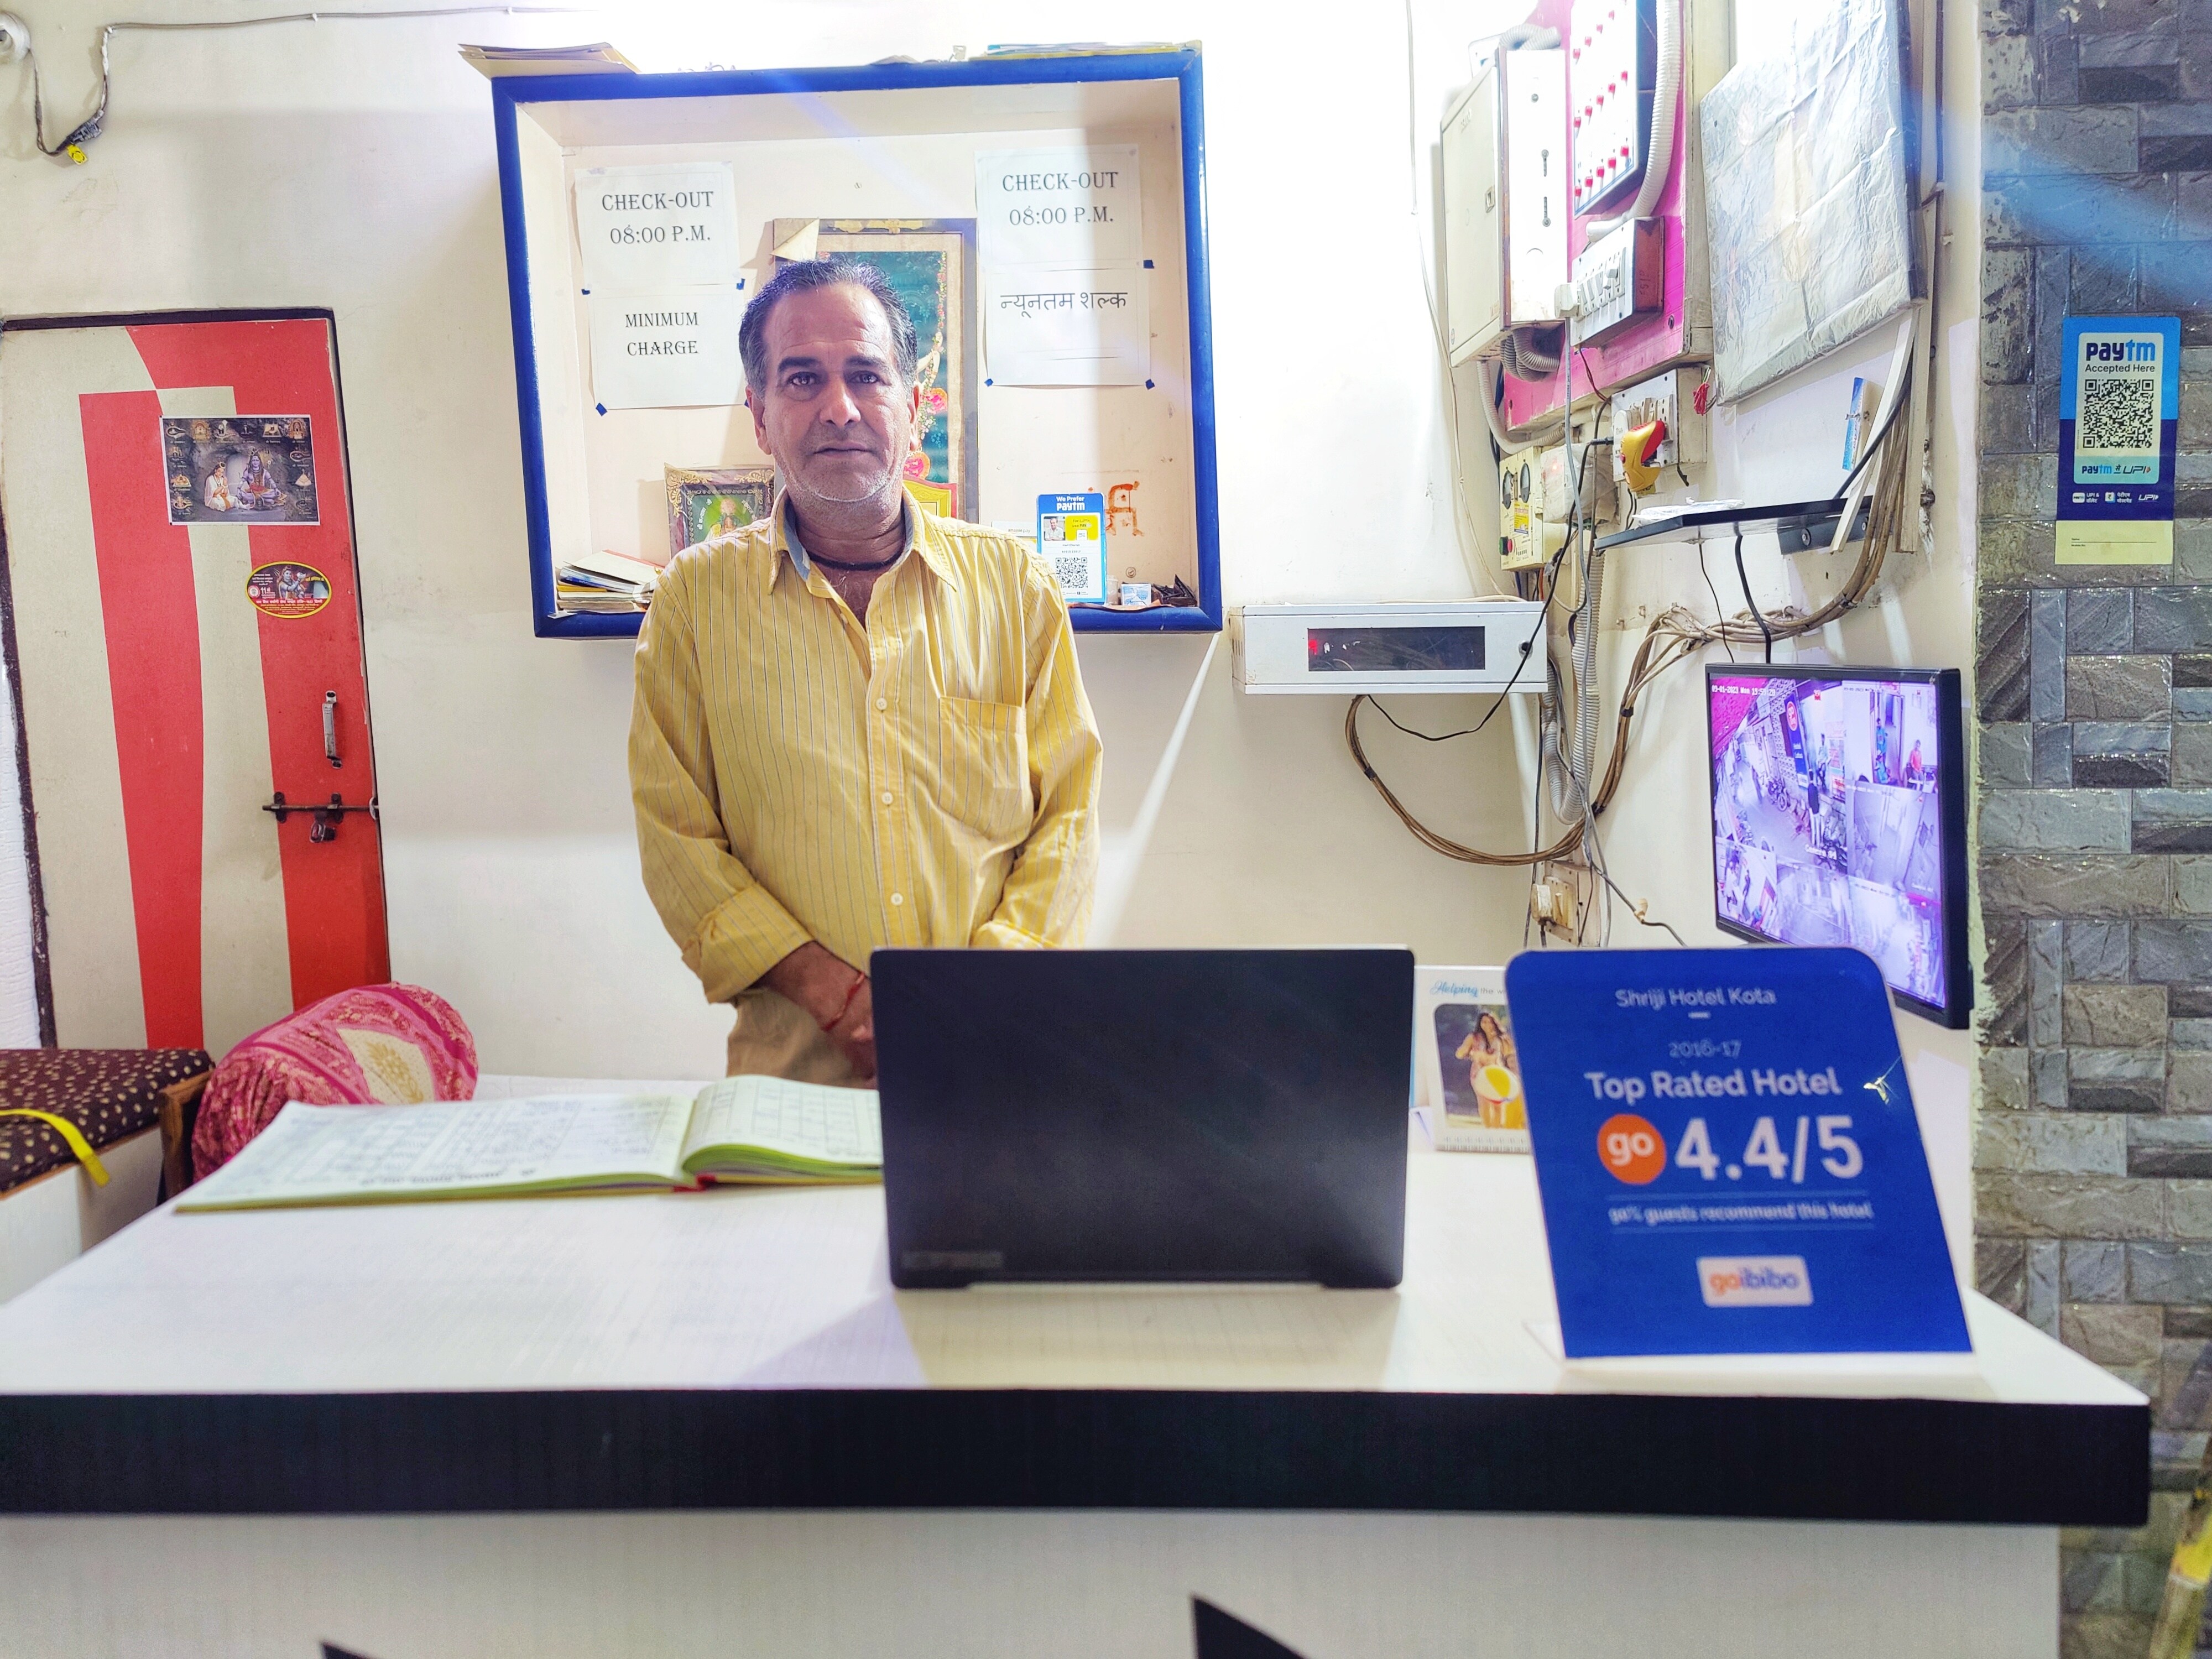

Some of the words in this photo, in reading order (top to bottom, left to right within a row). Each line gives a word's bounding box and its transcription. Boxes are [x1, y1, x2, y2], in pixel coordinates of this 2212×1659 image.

[1003, 171, 1118, 191] CHECK-OUT
[602, 191, 714, 211] CHECK-OUT
[1010, 206, 1066, 225] 08:00
[1074, 206, 1114, 223] P.M.
[610, 225, 665, 244] 08:00
[672, 225, 711, 241] P.M.
[1000, 293, 1075, 318] न्यूनतम
[625, 312, 699, 327] MINIMUM
[627, 341, 698, 356] CHARGE
[2085, 363, 2131, 373] Accepted
[2133, 364, 2155, 372] Here
[2122, 466, 2147, 474] UPI
[1430, 981, 1479, 998] Helping
[1615, 989, 1666, 1010] Shriji
[1670, 989, 1725, 1006] Hotel
[1729, 987, 1776, 1005] Kota
[1668, 1040, 1741, 1058] 2016-17
[1584, 1071, 1646, 1105] Top
[1653, 1069, 1747, 1097] Rated
[1752, 1067, 1841, 1095] Hotel
[1606, 1130, 1654, 1166] go
[1674, 1115, 1863, 1183] 4.4/5
[1644, 1204, 1698, 1227] guests
[1700, 1203, 1797, 1222] recommend
[1796, 1201, 1827, 1219] this
[1710, 1266, 1799, 1296] goibibo
